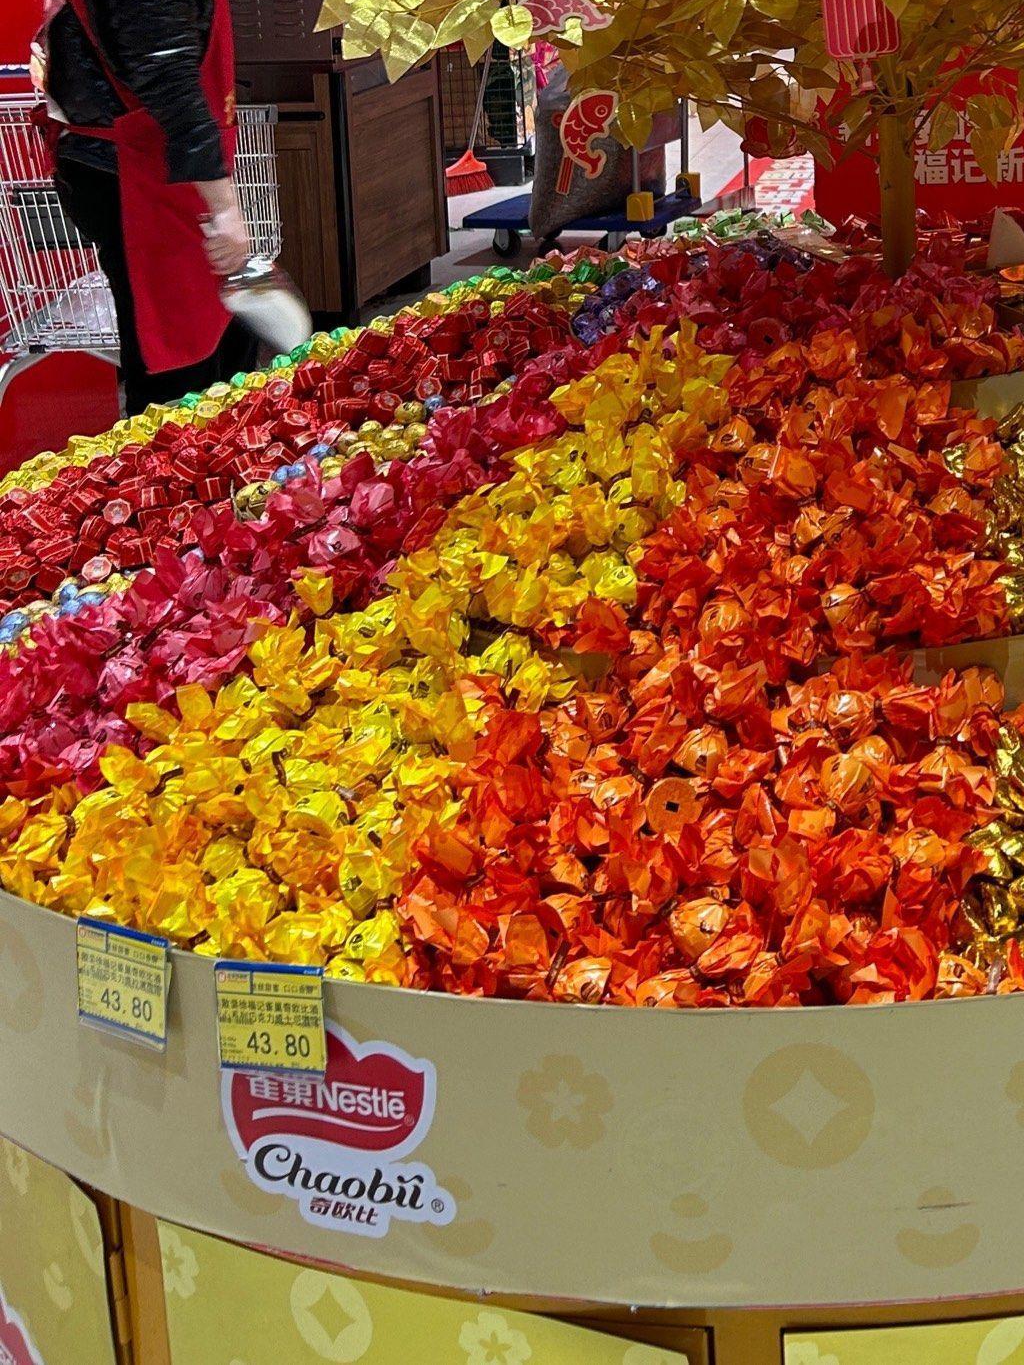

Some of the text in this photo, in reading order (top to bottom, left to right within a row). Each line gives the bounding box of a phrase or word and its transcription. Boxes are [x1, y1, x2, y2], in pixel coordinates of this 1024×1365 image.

[101, 988, 153, 1022] 43.80
[246, 1031, 311, 1058] 43.80
[309, 1197, 380, 1227] 奇欧比
